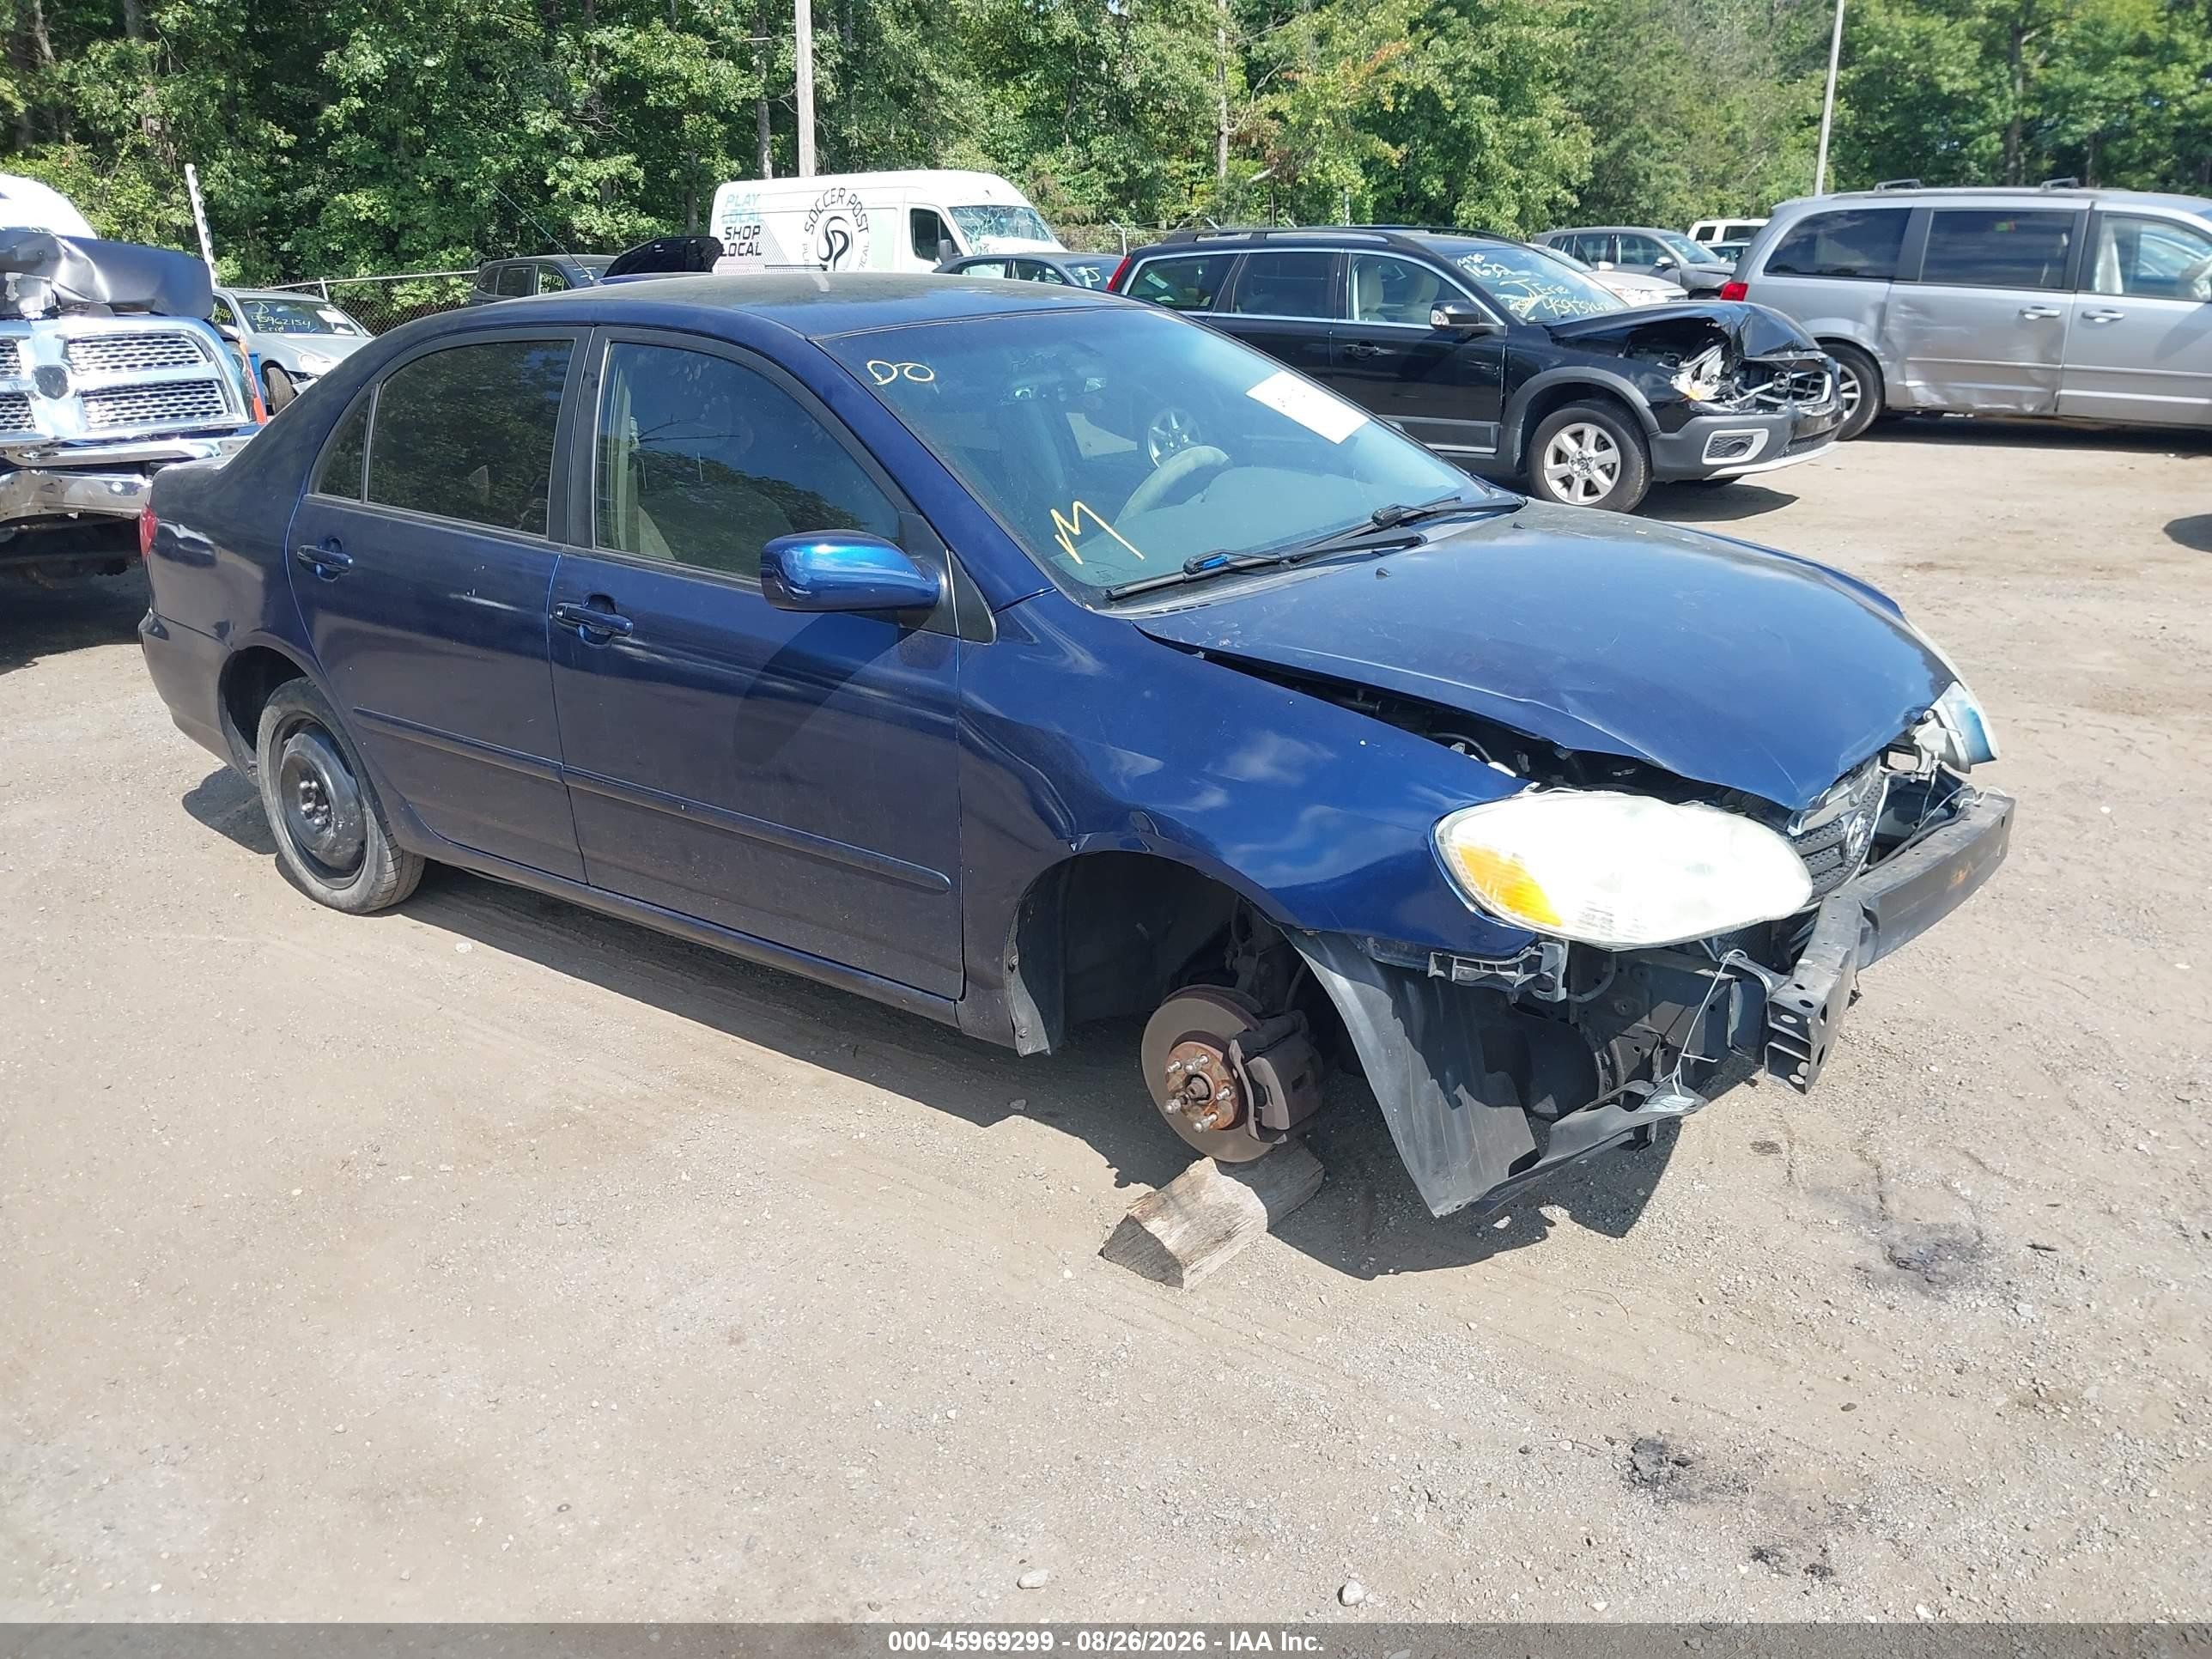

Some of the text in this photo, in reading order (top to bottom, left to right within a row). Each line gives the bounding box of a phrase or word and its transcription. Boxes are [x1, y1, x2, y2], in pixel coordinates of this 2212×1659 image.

[726, 193, 762, 208] PLAY
[721, 208, 762, 224] LOCAL
[804, 187, 870, 235] SOCCER POST
[724, 225, 761, 240] SHOP
[720, 241, 763, 257] LOCAL
[251, 315, 311, 329] 45962154
[1050, 501, 1146, 565] M
